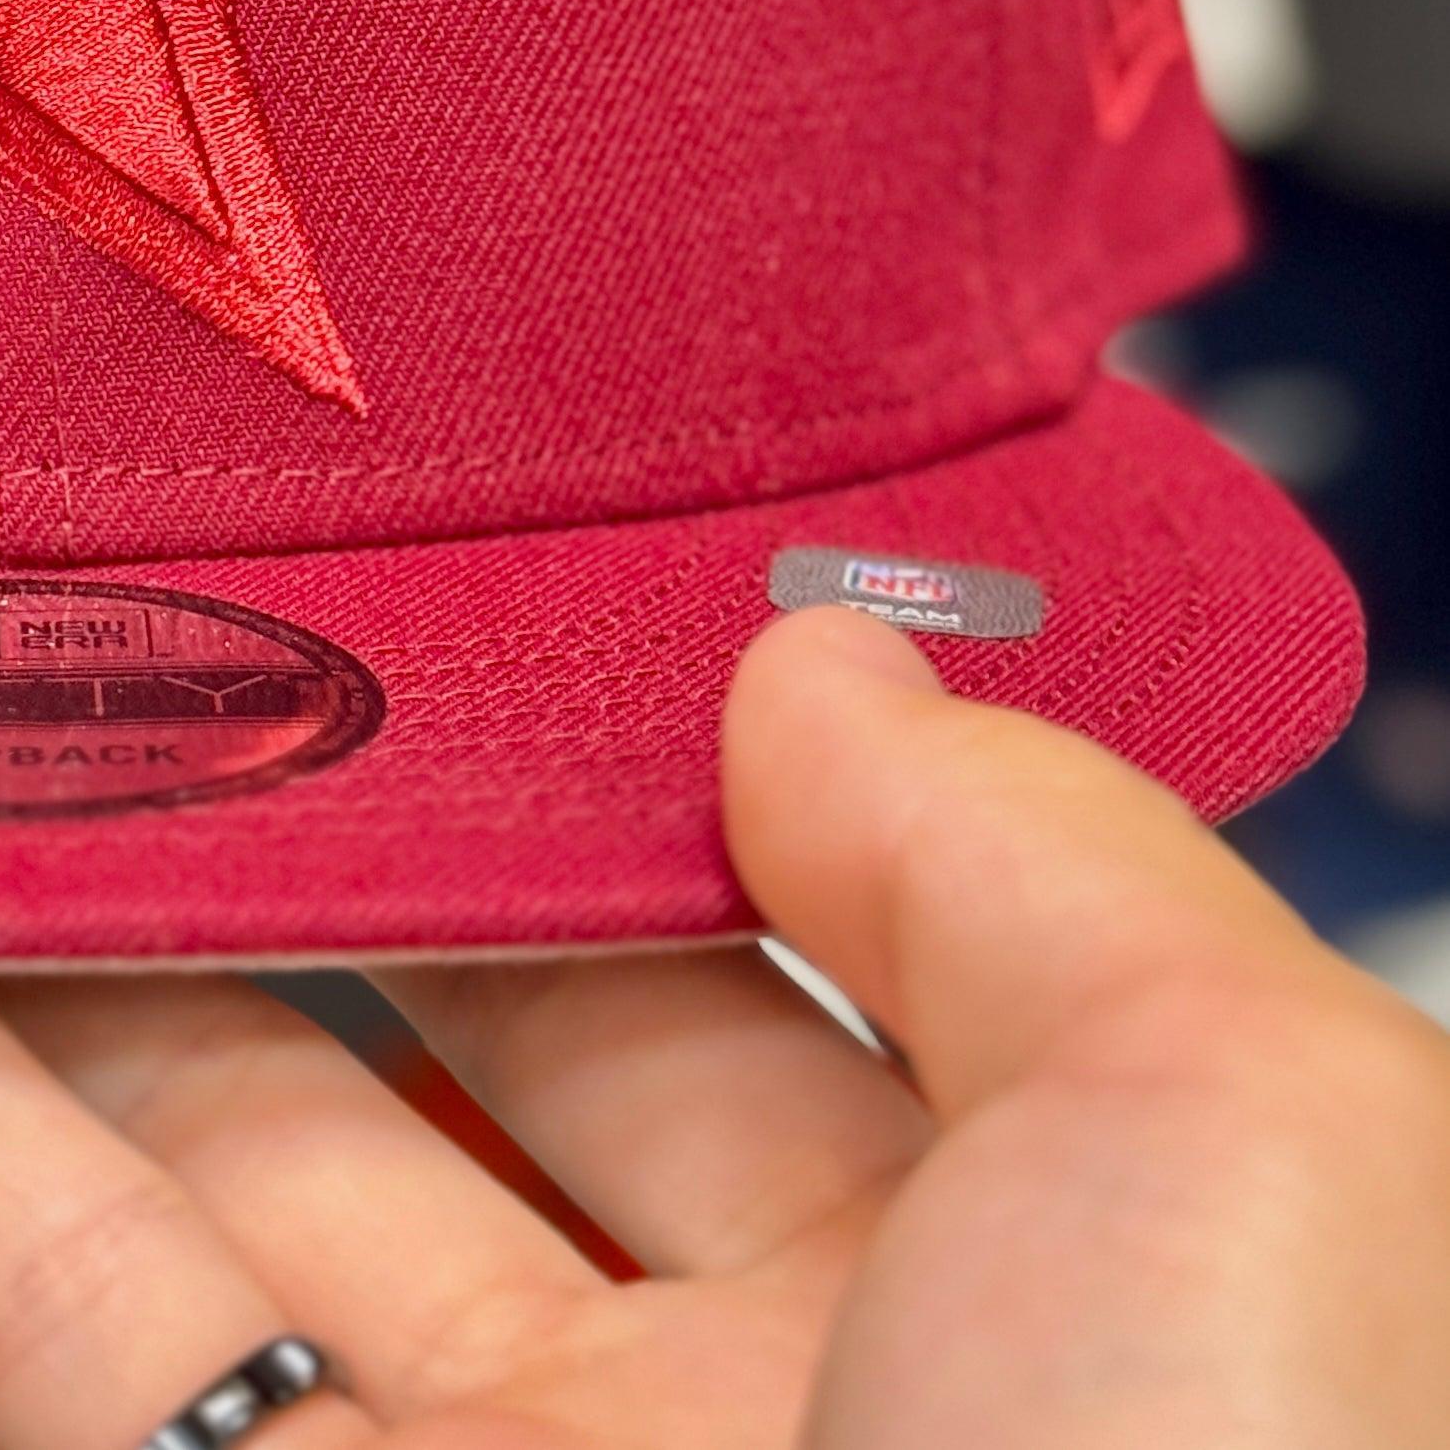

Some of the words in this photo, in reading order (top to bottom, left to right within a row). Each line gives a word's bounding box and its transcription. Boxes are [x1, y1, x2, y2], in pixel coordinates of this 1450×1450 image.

[865, 575, 954, 602] NFL
[20, 621, 126, 634] NEW
[20, 635, 129, 649] ERA
